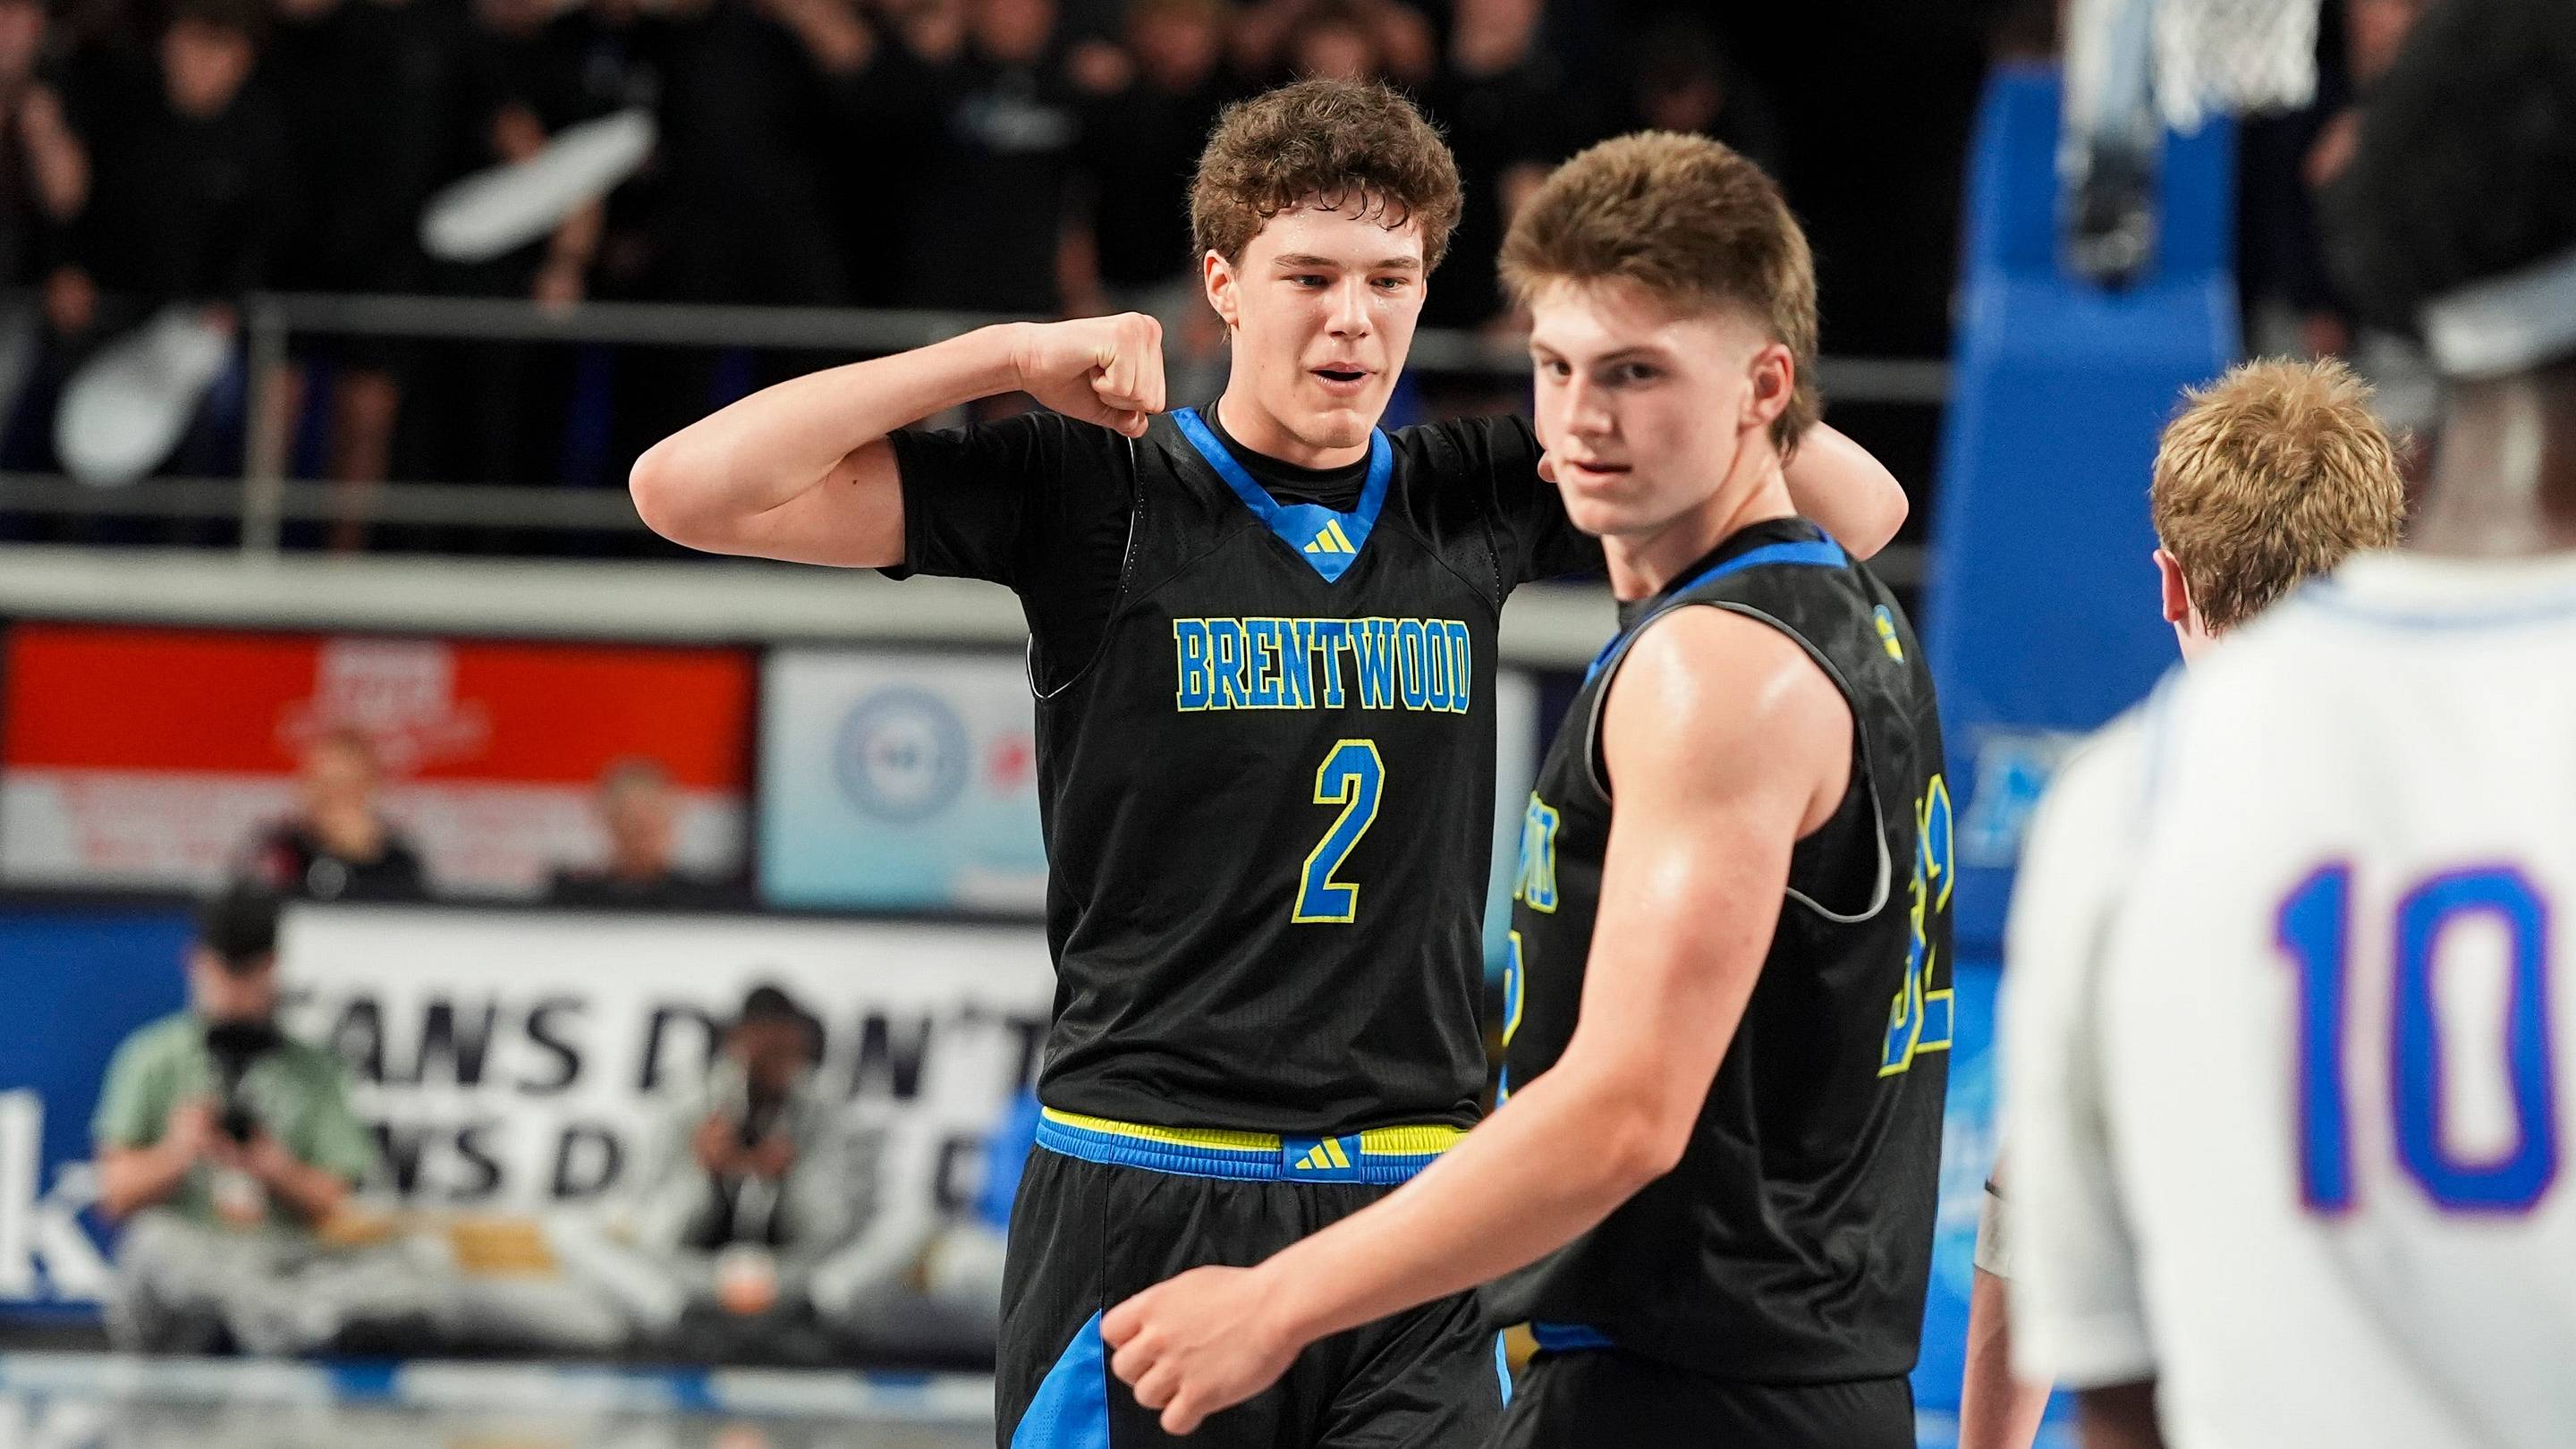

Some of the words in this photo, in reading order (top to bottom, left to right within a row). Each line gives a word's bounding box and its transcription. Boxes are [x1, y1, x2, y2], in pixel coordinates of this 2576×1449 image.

[1173, 616, 1471, 715] BRENTWOOD
[1291, 739, 1385, 923] 2
[2272, 860, 2556, 1212] 10
